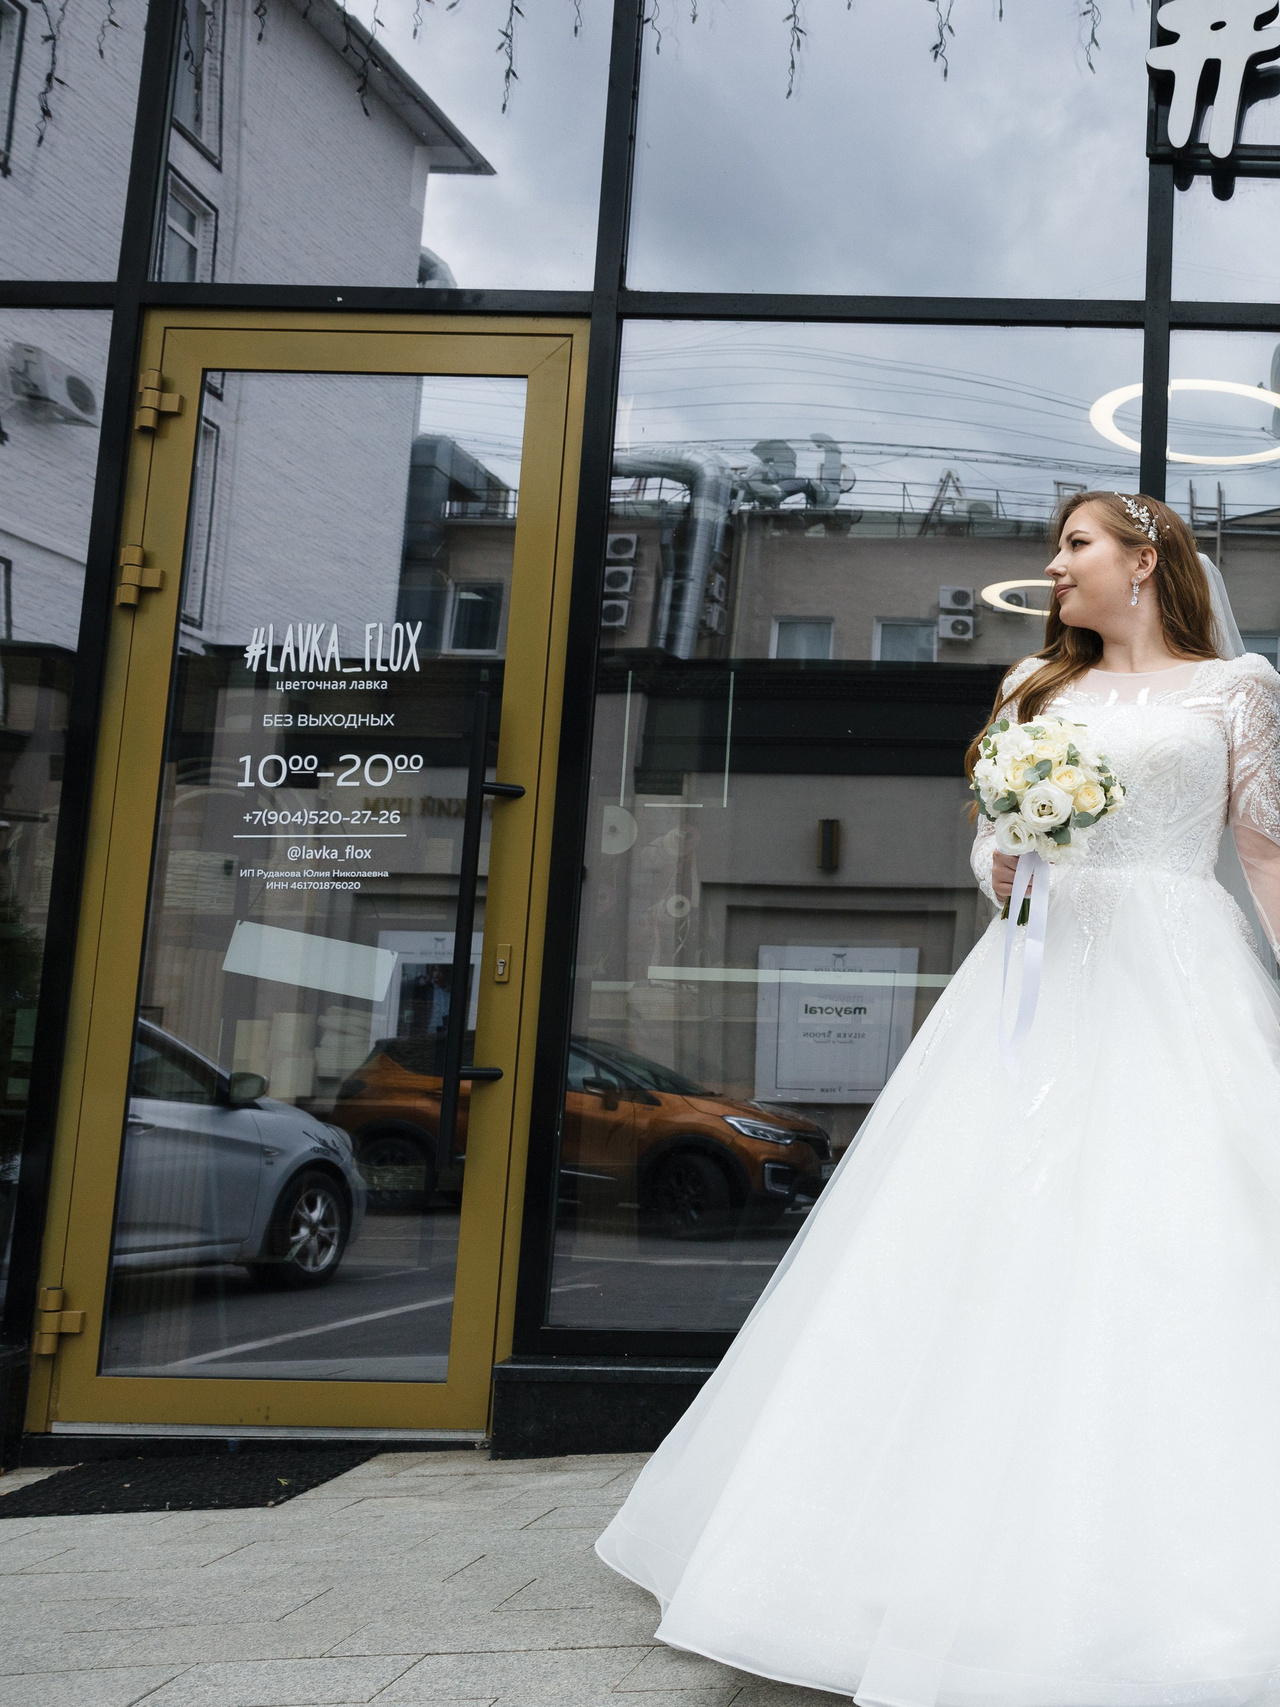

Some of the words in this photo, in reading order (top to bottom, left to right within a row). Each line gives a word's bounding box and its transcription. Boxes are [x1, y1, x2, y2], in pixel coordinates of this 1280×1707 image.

[243, 621, 423, 673] #LAVKA_FLOX
[275, 680, 347, 693] цветочная
[349, 680, 388, 690] лавка
[263, 714, 293, 727] БЕЗ
[297, 713, 395, 729] ВЫХОДНЫХ
[243, 809, 401, 827] +7(904)520-27-26
[287, 845, 372, 862] @lavka_flox
[239, 869, 255, 877] ИП
[256, 869, 301, 879] Рудакова
[303, 869, 330, 877] Юлия
[332, 869, 389, 878] Николаевна
[266, 881, 288, 890] ИНН
